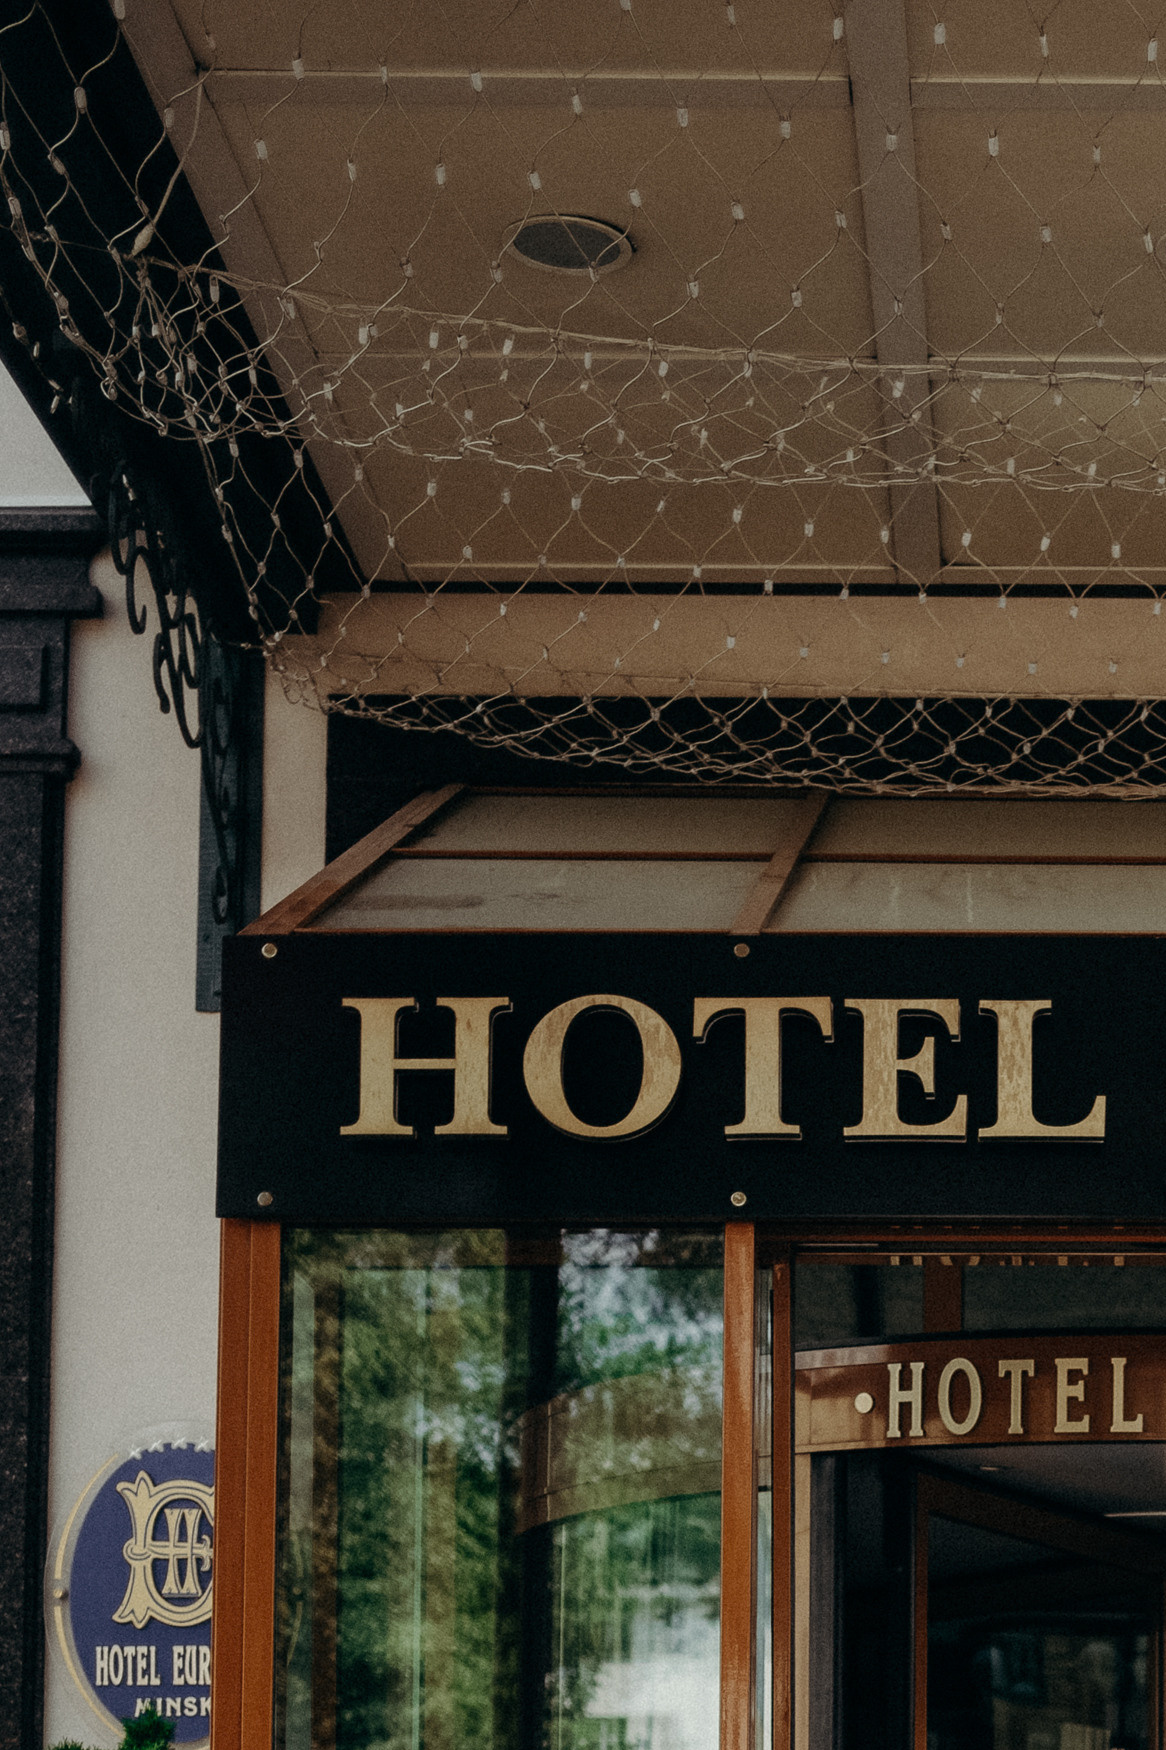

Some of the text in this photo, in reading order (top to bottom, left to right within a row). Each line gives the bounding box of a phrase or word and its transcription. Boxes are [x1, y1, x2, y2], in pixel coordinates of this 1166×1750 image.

[339, 994, 1107, 1142] HOTEL
[886, 1357, 1143, 1437] HOTEL
[95, 1644, 211, 1686] HOTEL EUR
